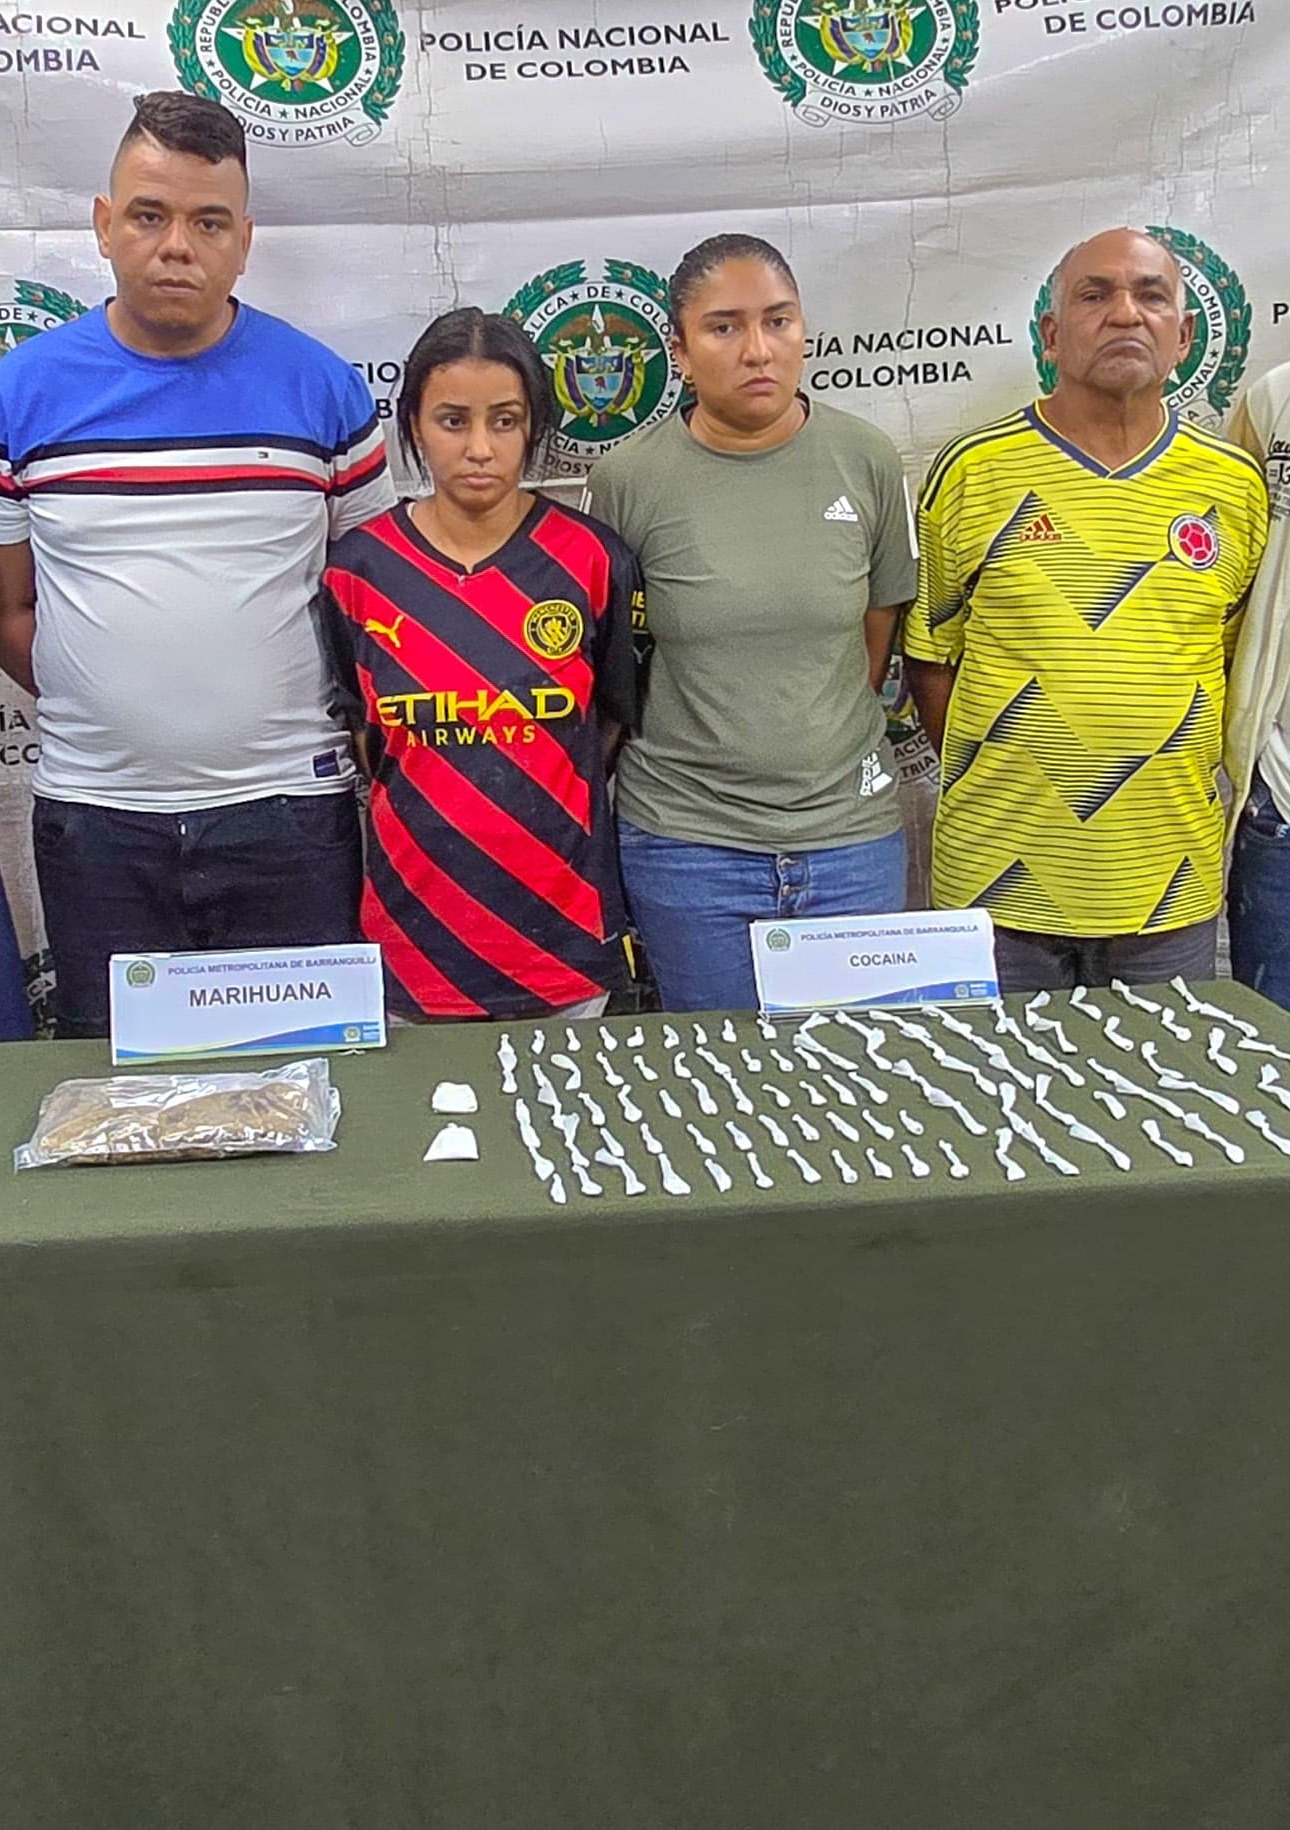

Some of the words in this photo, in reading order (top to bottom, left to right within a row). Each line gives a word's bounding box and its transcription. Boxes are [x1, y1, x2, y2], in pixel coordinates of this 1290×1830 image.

[1044, 12, 1087, 34] DE
[1096, 1, 1255, 30] COLOMBIA
[421, 25, 548, 52] POLICÍA
[559, 22, 730, 50] NACIONAL
[465, 63, 507, 81] DE
[516, 56, 690, 78] COLOMBIA
[879, 45, 951, 97] NACIONAL
[295, 75, 371, 119] NACIONAL
[820, 96, 861, 118] DIOS
[863, 106, 875, 118] Y
[880, 89, 937, 117] PATRIA
[278, 128, 291, 142] Y
[296, 116, 355, 141] PATRIA
[586, 286, 611, 299] DE
[1180, 265, 1223, 341] OLOMBIA
[853, 324, 1013, 355] NACIONAL
[811, 361, 973, 390] COLOMBIA
[1167, 362, 1221, 409] CIONAL
[376, 686, 575, 727] ETIHAD
[406, 725, 536, 748] AIRWAYS
[901, 755, 936, 778] TRIA
[835, 929, 902, 939] METROPOLITANA
[916, 924, 979, 935] BARRANQUILLA
[208, 962, 289, 974] METROPOLITANA
[291, 960, 303, 969] DE
[849, 952, 918, 968] COCAINA
[190, 982, 332, 1008] MARIHUANA
